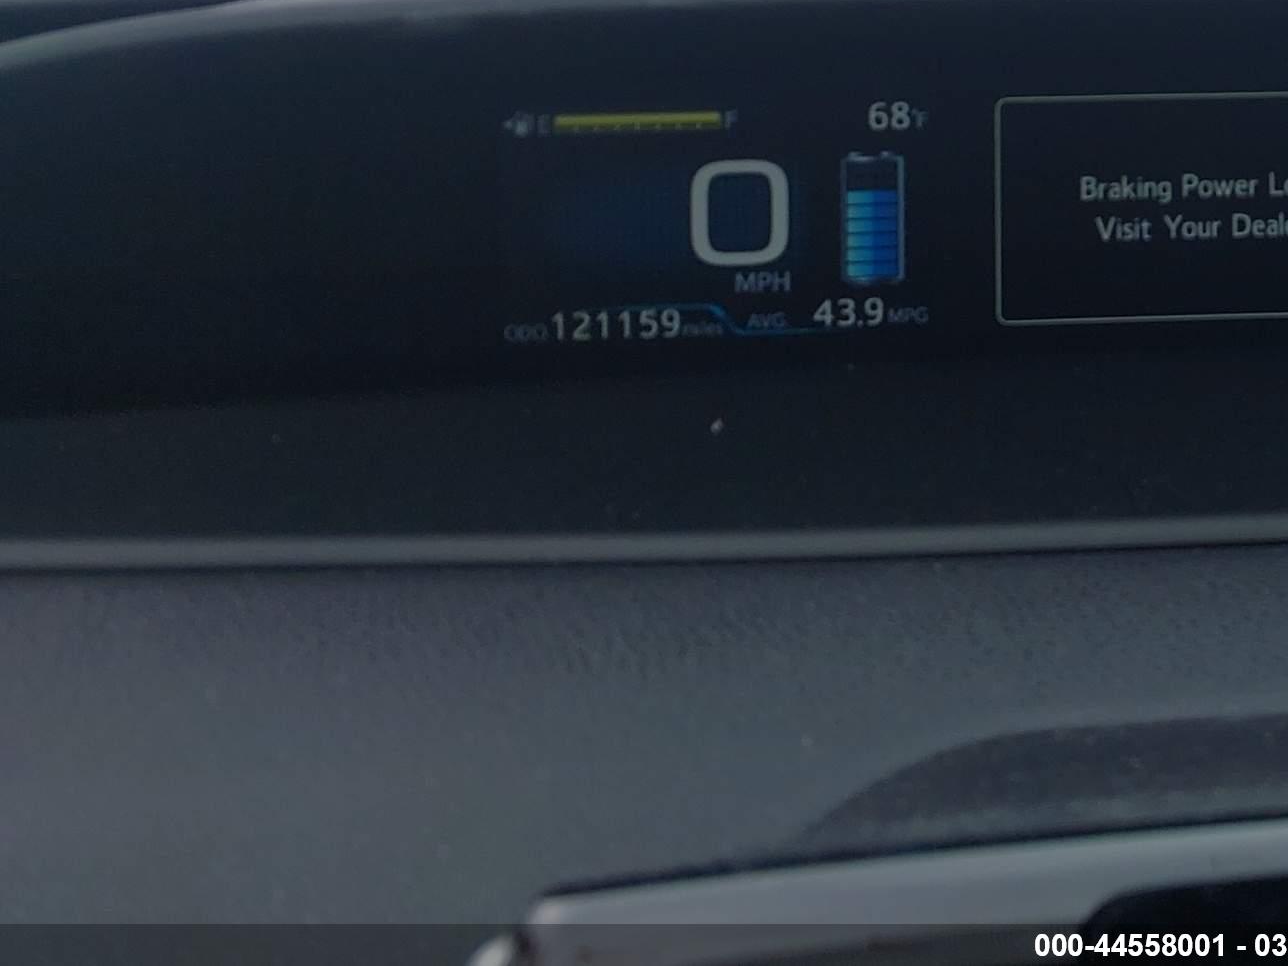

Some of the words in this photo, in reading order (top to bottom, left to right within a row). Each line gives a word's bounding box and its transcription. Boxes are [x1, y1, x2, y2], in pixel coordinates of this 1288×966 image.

[1079, 175, 1173, 204] Braking
[1181, 172, 1258, 199] Power
[690, 159, 790, 267] 0
[1095, 215, 1152, 242] Visit
[1164, 213, 1221, 240] Your
[734, 272, 792, 293] MPH
[551, 307, 682, 343] 121159
[813, 296, 884, 328] 43.9
[887, 306, 929, 325] MPG
